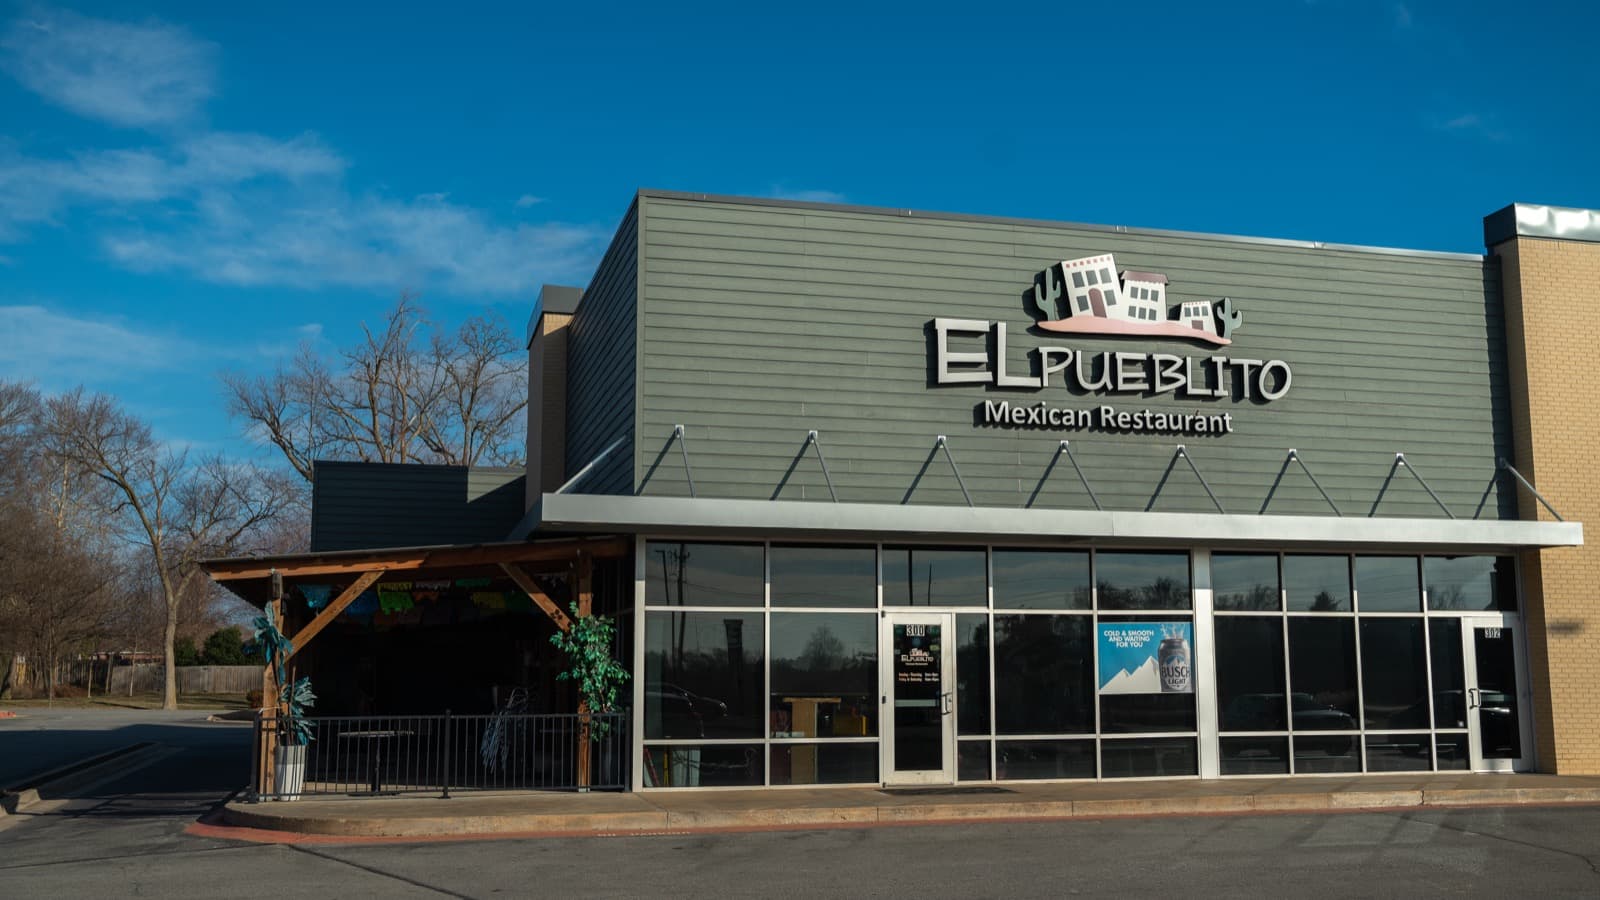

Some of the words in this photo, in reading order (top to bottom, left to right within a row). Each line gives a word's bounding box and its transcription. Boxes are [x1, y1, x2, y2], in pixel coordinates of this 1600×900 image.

[935, 318, 1041, 387] EL
[1038, 346, 1292, 400] PUEBLITO
[985, 400, 1092, 428] Mexican
[1100, 405, 1233, 433] Restaurant
[907, 624, 925, 636] 300
[1485, 627, 1500, 638] 302
